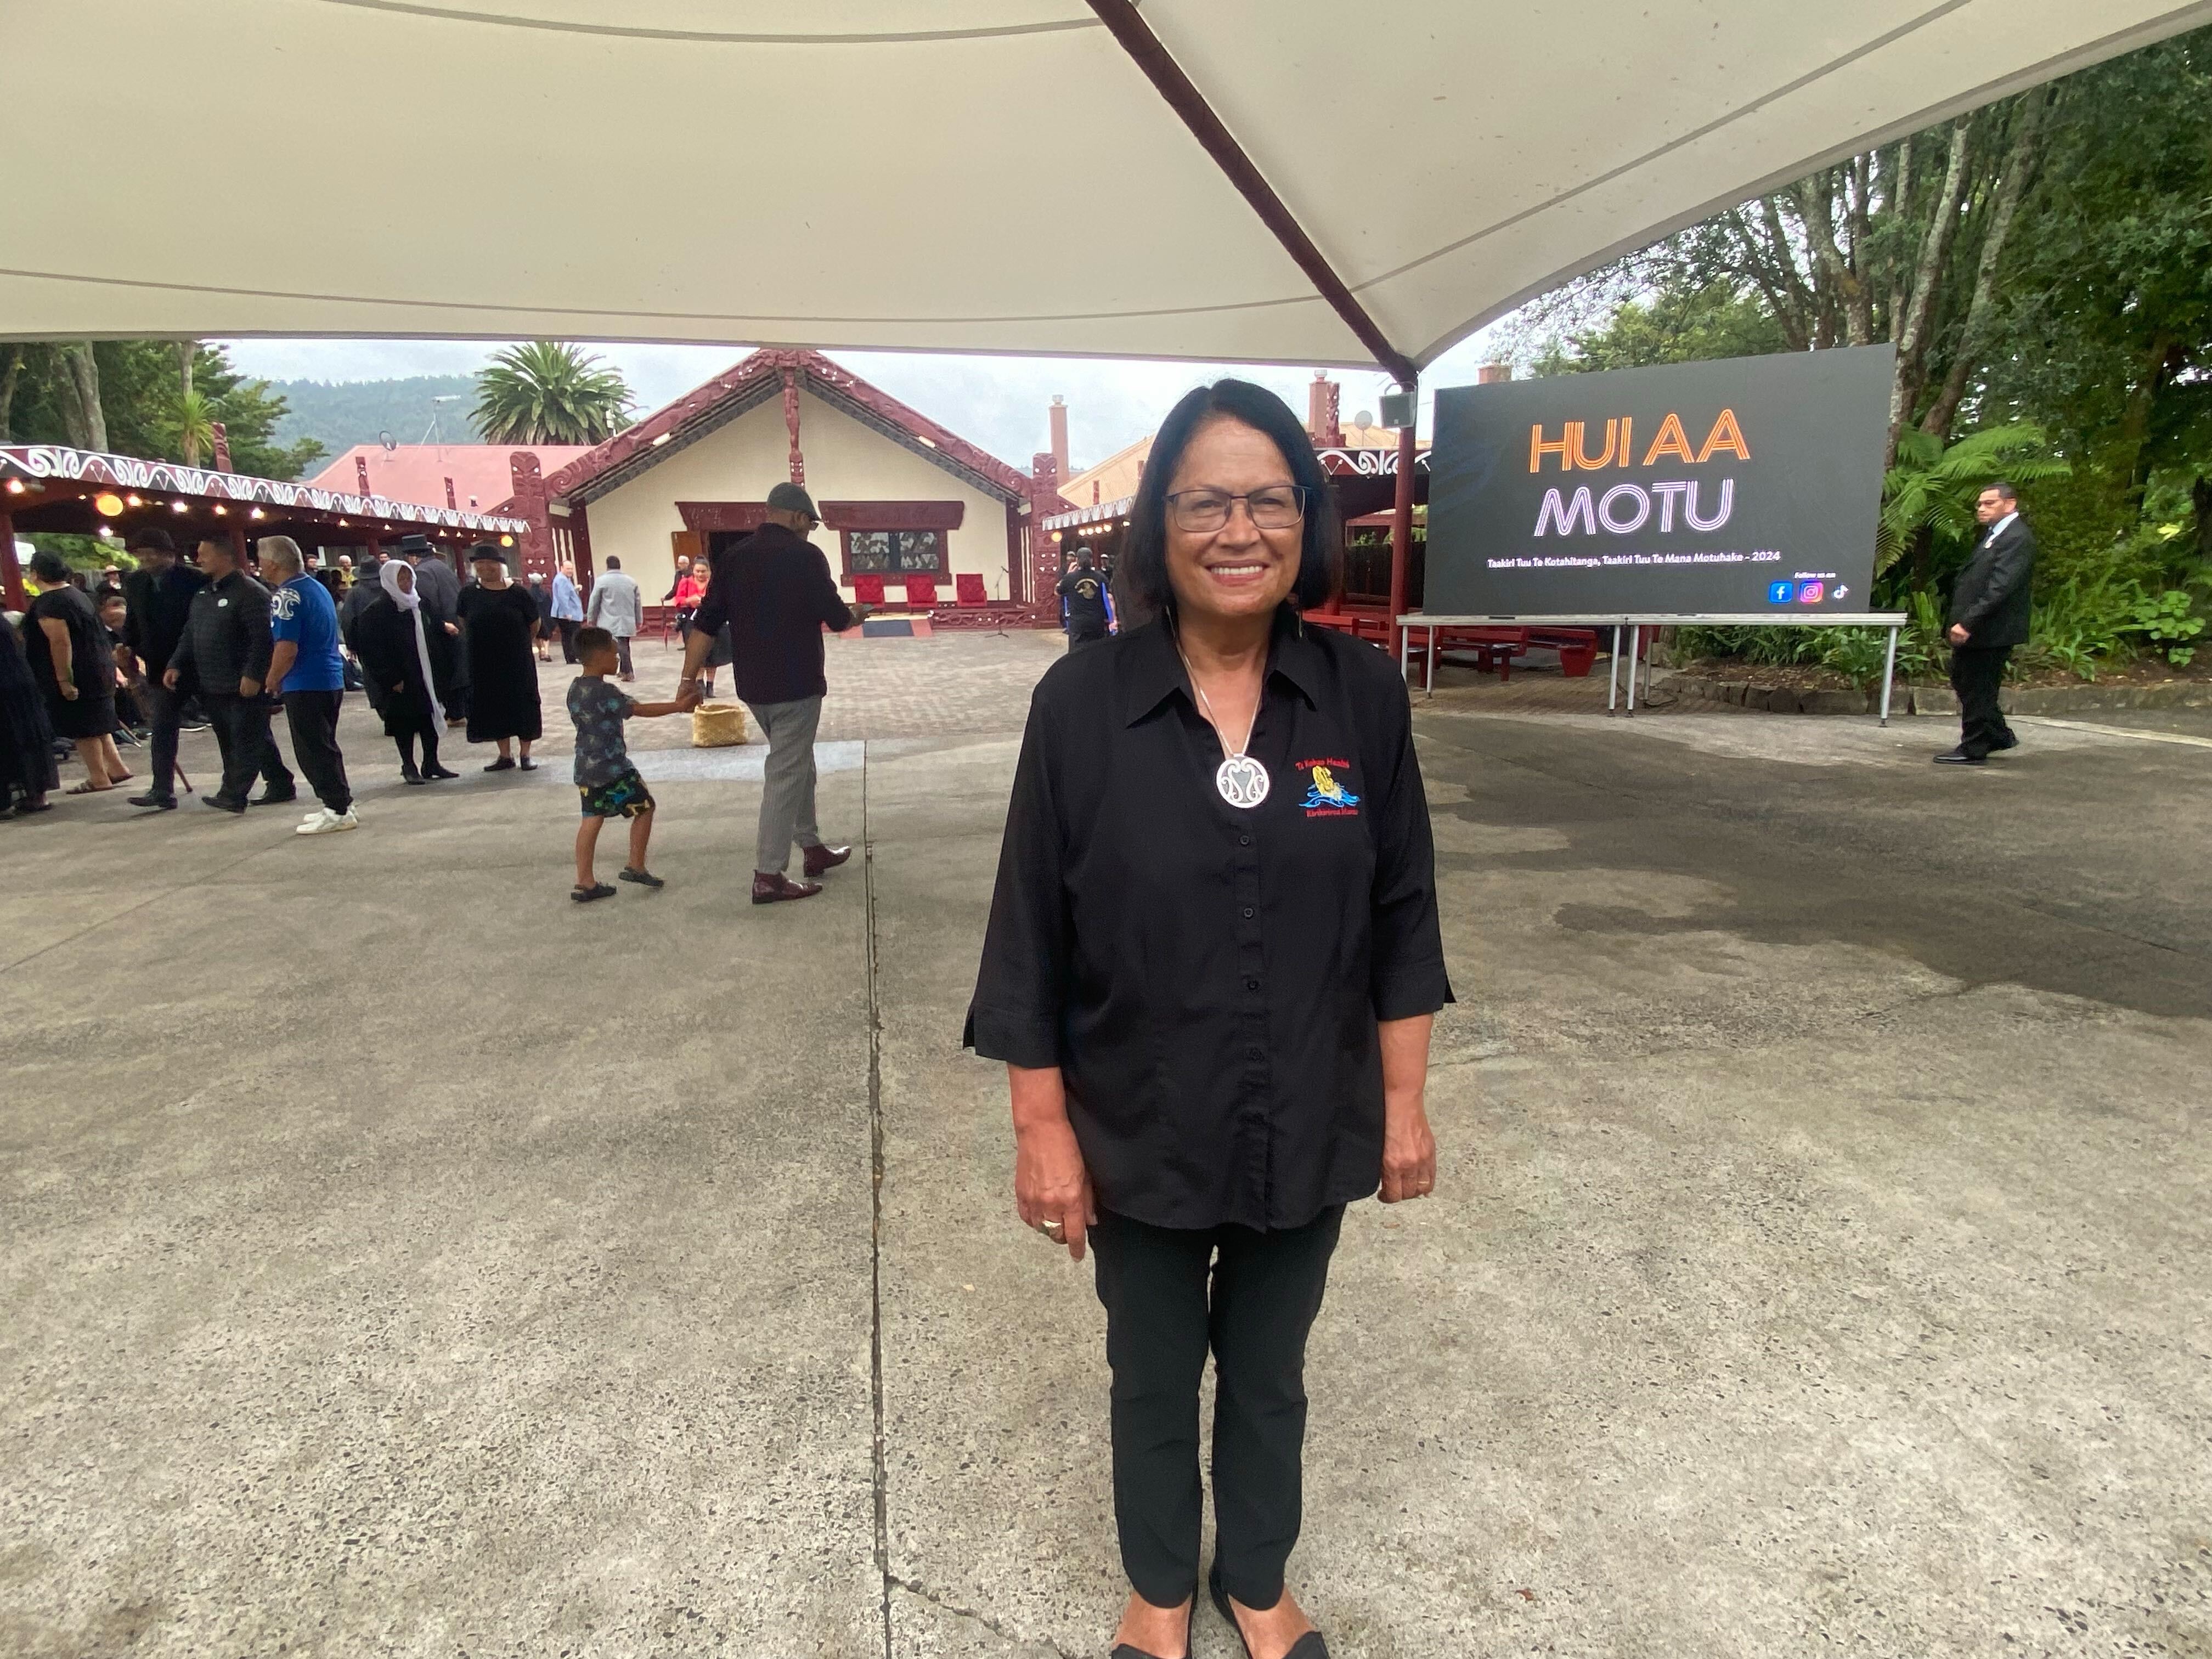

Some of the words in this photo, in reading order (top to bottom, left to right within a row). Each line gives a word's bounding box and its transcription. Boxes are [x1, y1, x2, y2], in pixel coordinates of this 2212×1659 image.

[1530, 416, 1632, 473] HUI
[1643, 409, 1751, 466] AA
[1534, 478, 1734, 537] MOTU
[1487, 559, 1515, 568] Taakiri
[1516, 558, 1531, 567] Tuu
[1532, 557, 1543, 566] Te
[1544, 556, 1601, 568] Kotahitanga,
[1602, 555, 1633, 565] Taakiri
[1634, 554, 1650, 563] Tuu
[1652, 554, 1663, 563] Te
[1664, 553, 1691, 563] Mana
[1693, 552, 1743, 562] Motuhake
[1752, 551, 1781, 561] 2024
